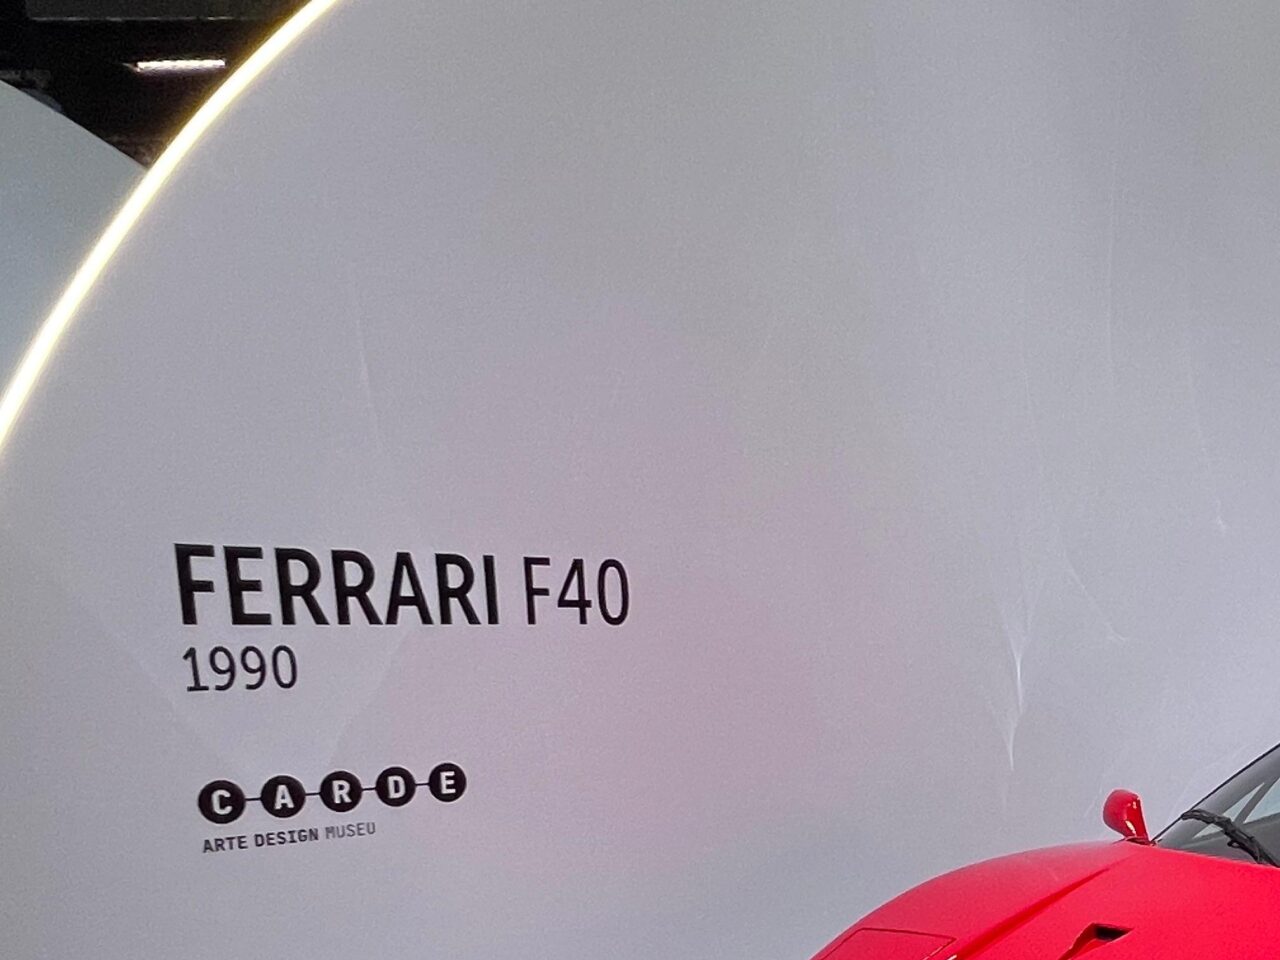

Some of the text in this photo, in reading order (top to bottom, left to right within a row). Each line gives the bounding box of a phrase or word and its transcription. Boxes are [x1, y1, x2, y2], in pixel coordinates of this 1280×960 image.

[173, 543, 630, 626] FERRARI F40
[181, 645, 298, 692] 1990
[202, 821, 377, 853] ARTE DESIGN MUSEU
